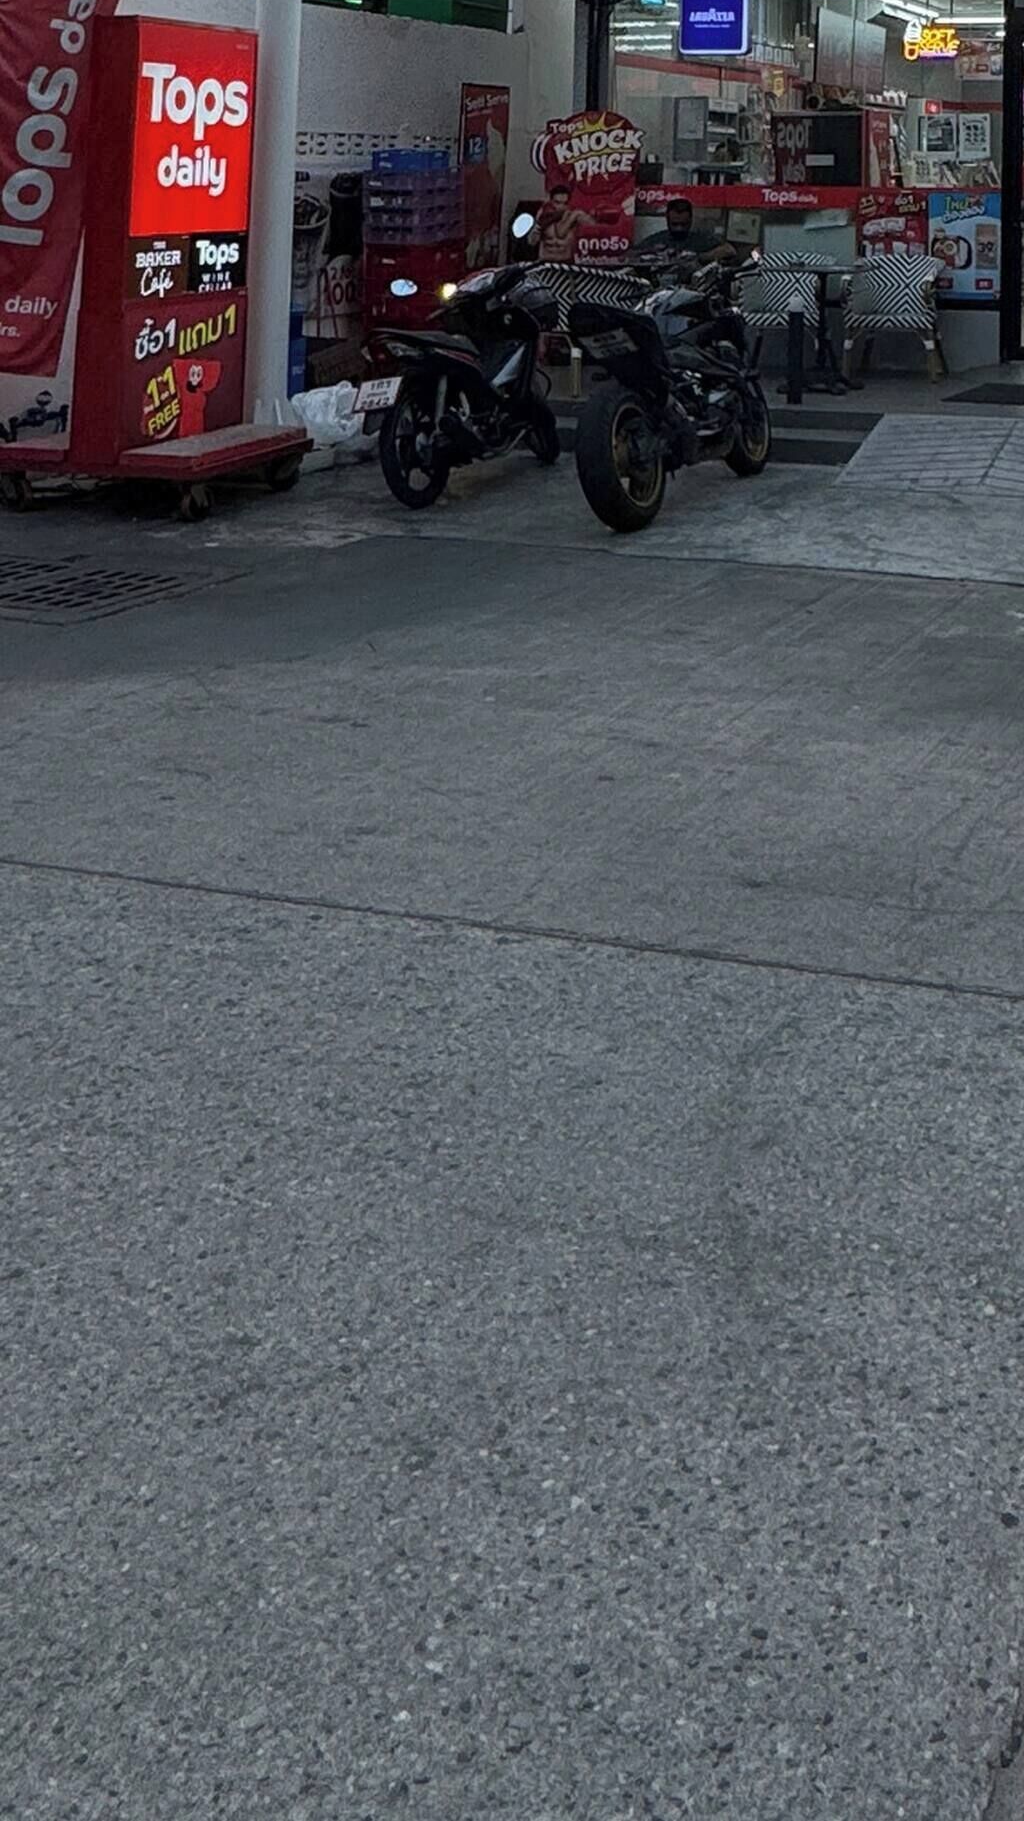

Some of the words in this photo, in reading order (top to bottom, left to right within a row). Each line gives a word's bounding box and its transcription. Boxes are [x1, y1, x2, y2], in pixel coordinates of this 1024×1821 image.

[142, 62, 249, 140] Tops
[554, 129, 645, 164] KNOCK
[157, 144, 227, 197] daily
[574, 153, 636, 181] PRICE
[762, 188, 797, 206] Tops
[135, 250, 181, 268] BAKER
[195, 240, 240, 270] Tops
[5, 295, 58, 319] daily
[147, 398, 181, 437] FREE
